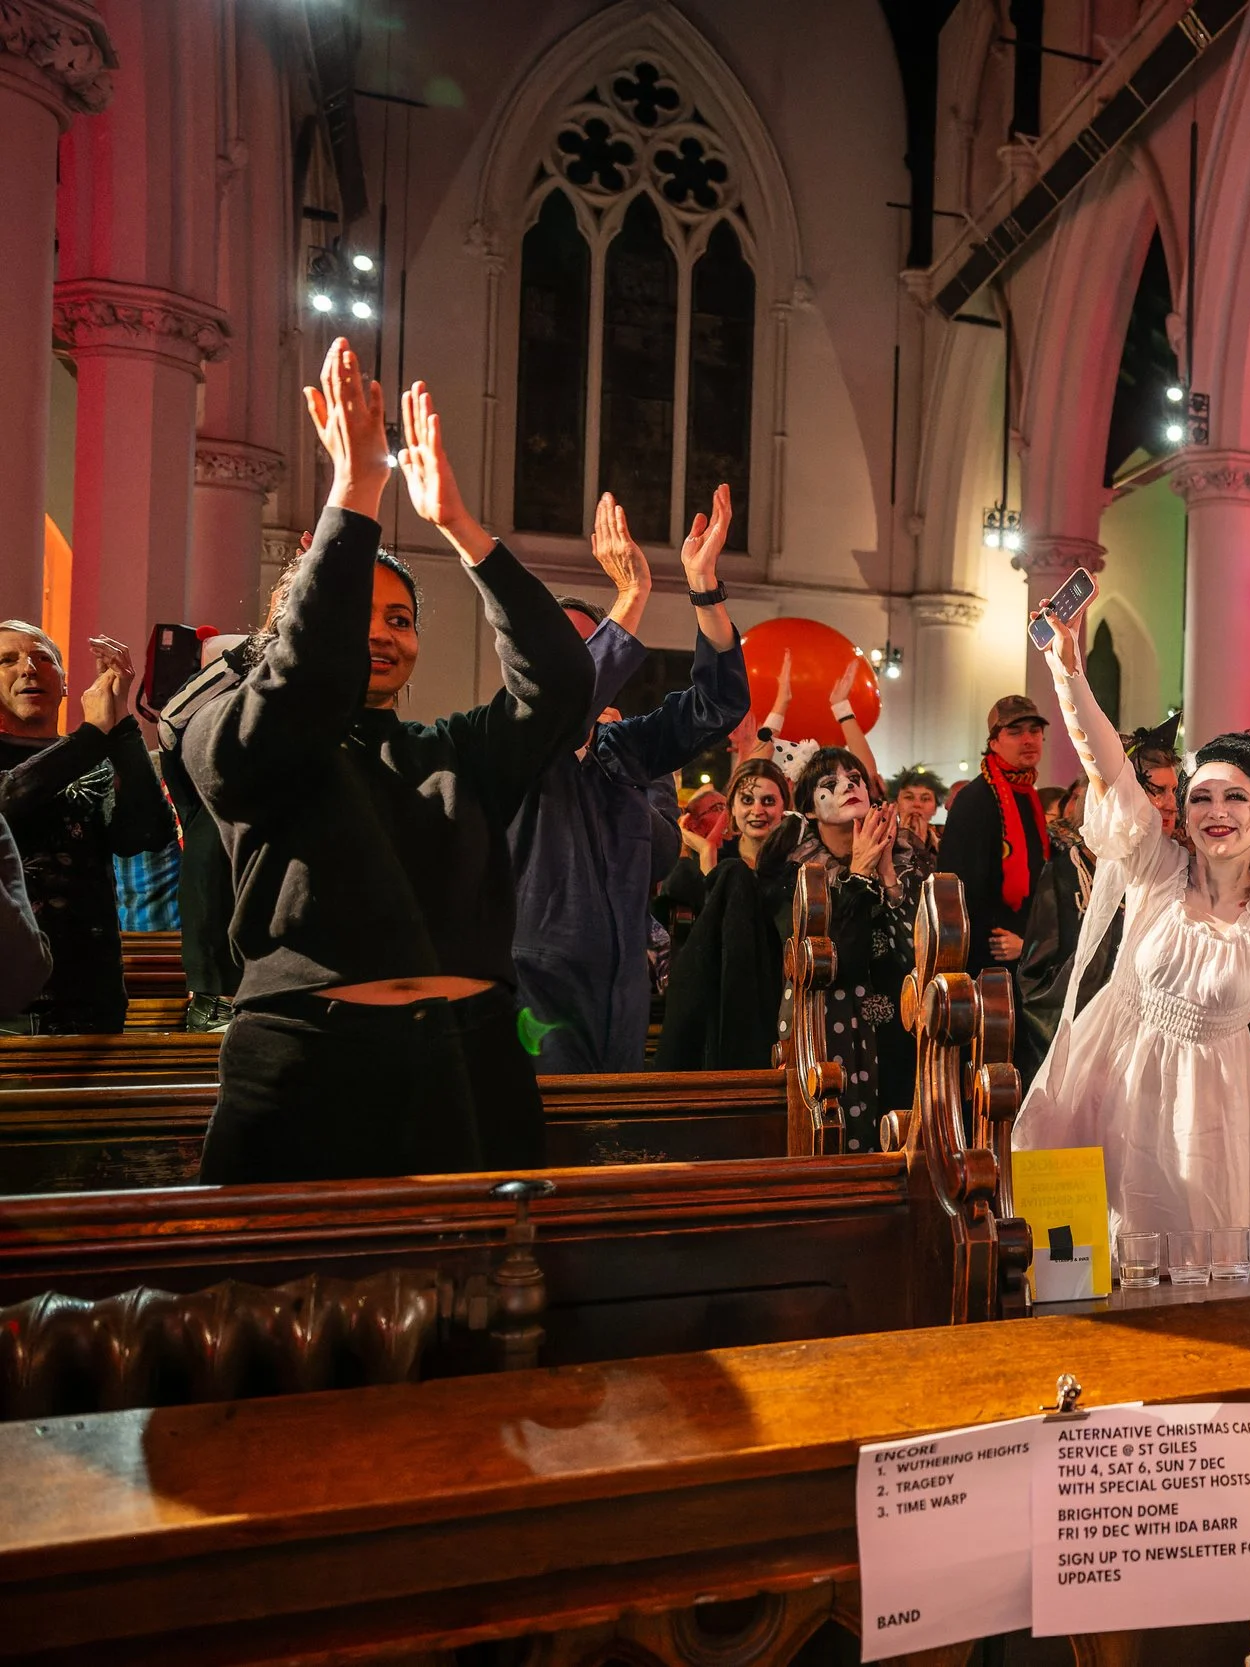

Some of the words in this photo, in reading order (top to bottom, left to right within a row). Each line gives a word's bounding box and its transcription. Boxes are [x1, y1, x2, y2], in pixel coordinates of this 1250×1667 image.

[1058, 1426, 1152, 1441] ALTERNATIVE
[1156, 1423, 1229, 1437] CHRISTMAS
[875, 1444, 938, 1462] ENCORE
[878, 1467, 886, 1476] 1.
[897, 1452, 973, 1472] WUTHERING
[978, 1443, 1029, 1459] HEIGHTS
[1059, 1445, 1117, 1459] SERVICE
[1123, 1444, 1134, 1456] @
[1139, 1443, 1154, 1456] ST
[1159, 1441, 1197, 1454] GILES
[1058, 1465, 1086, 1477] THU
[1090, 1464, 1102, 1476] 4,
[1108, 1462, 1133, 1475] SAT
[1138, 1462, 1150, 1474] 6,
[1156, 1460, 1184, 1473] SUN
[1189, 1459, 1196, 1471] 7
[1201, 1457, 1225, 1470] DEC
[877, 1486, 888, 1497] 2.
[896, 1474, 954, 1492] TRAGEDY
[1058, 1482, 1094, 1495] WITH
[1100, 1480, 1157, 1493] SPECIAL
[1161, 1476, 1206, 1490] GUEST
[877, 1507, 888, 1518] 3.
[897, 1500, 925, 1514] TIME
[930, 1493, 967, 1508] WARP
[1058, 1506, 1132, 1521] BRIGHTON
[1138, 1503, 1178, 1517] DOME
[1058, 1527, 1079, 1540] FRI
[1084, 1526, 1098, 1538] 19
[1102, 1524, 1129, 1537] DEC
[1135, 1522, 1170, 1535] WITH
[1175, 1520, 1198, 1533] IDA
[1203, 1517, 1237, 1531] BARR
[1059, 1552, 1094, 1566] SIGN
[1099, 1551, 1117, 1564] UP
[1122, 1550, 1141, 1562] TO
[1146, 1544, 1236, 1560] NEWSLETTER
[1058, 1569, 1121, 1585] UPDATES
[877, 1610, 920, 1629] BAND
